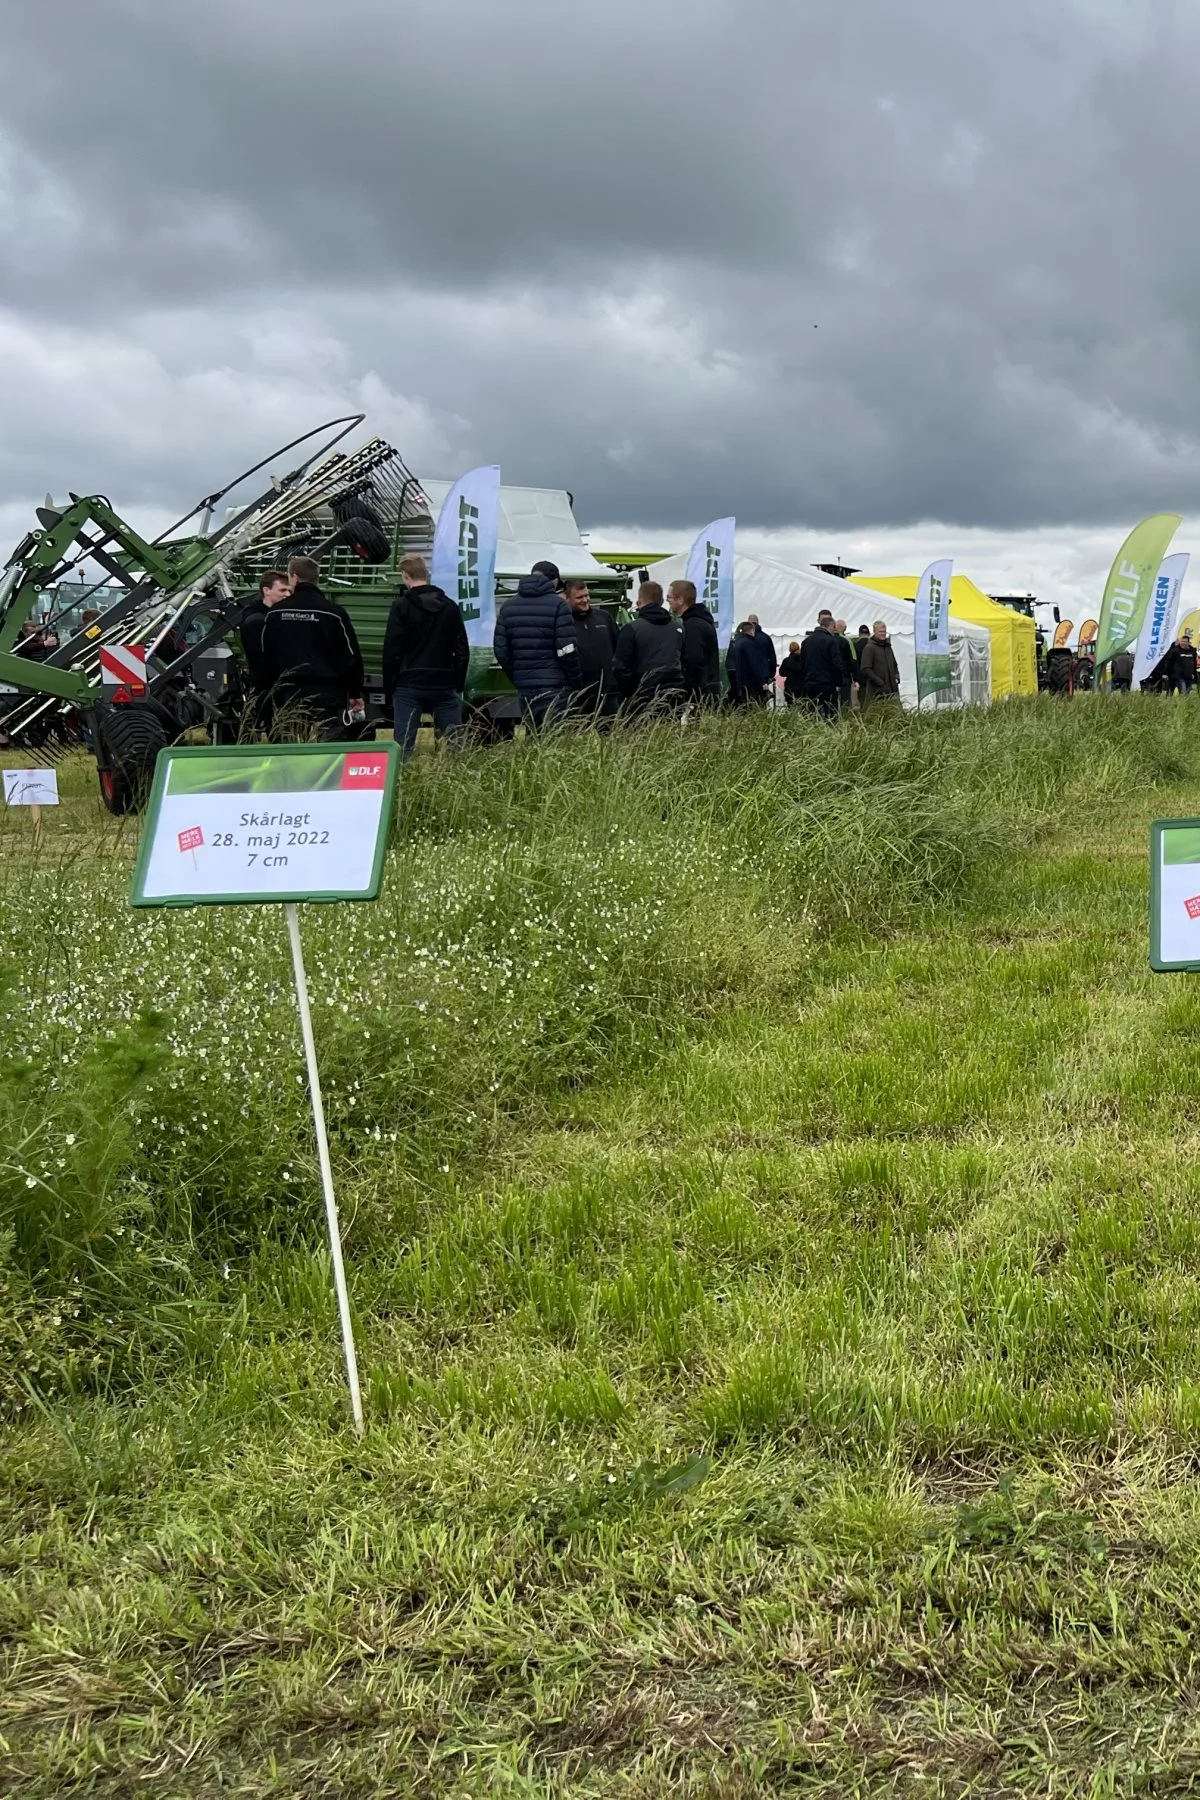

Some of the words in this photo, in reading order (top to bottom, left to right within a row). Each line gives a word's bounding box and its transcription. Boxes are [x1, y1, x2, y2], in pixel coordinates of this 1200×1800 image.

[458, 495, 480, 621] FENDT
[703, 541, 720, 629] ENDT
[928, 574, 941, 642] FENDT
[1109, 559, 1141, 618] DLF
[1151, 576, 1170, 645] LEMKEN
[357, 766, 381, 776] DLF
[212, 834, 239, 847] 28.
[247, 833, 281, 849] maj
[287, 831, 330, 845] 2022
[239, 812, 311, 828] Skårlagt
[247, 854, 258, 867] 7
[263, 856, 289, 867] cm
